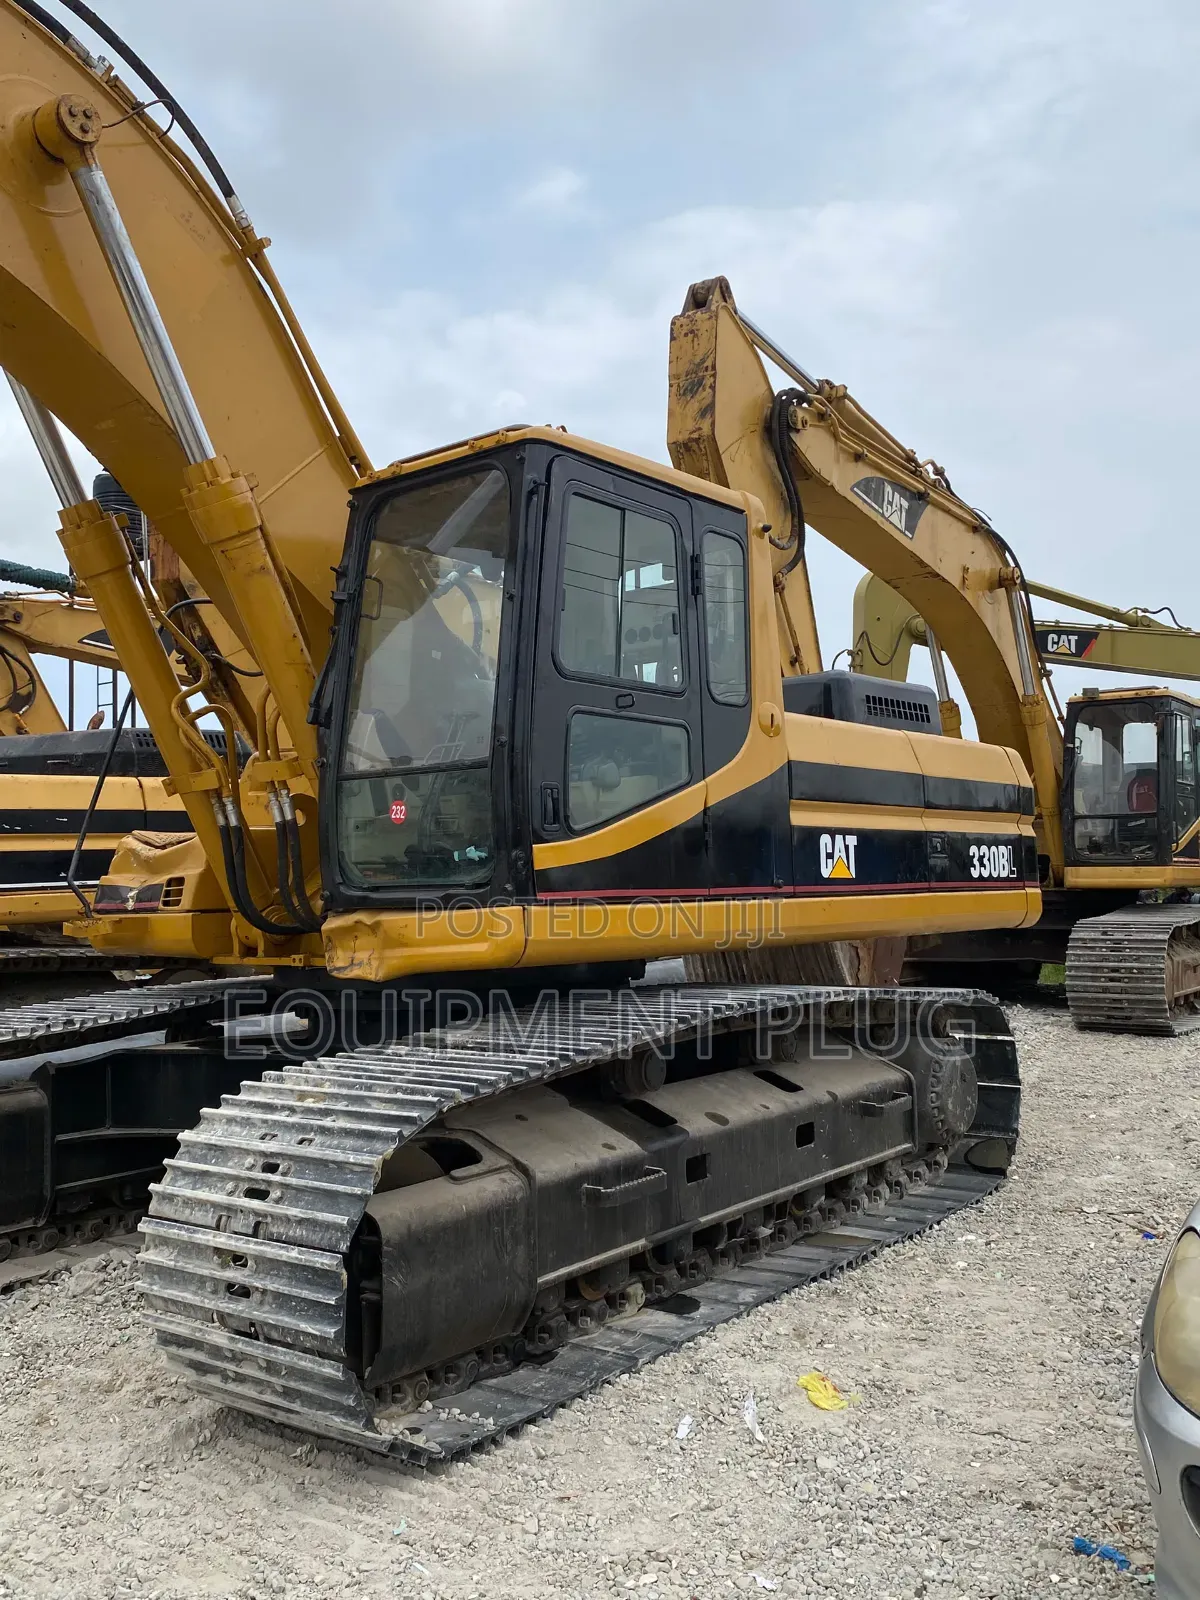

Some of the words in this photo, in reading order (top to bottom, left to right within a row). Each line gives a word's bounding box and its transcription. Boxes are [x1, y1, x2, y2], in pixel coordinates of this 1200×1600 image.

[883, 481, 909, 533] CAT
[1047, 633, 1078, 654] CAT
[391, 805, 405, 818] 232
[820, 833, 857, 879] CAT
[969, 845, 1017, 878] 330BL
